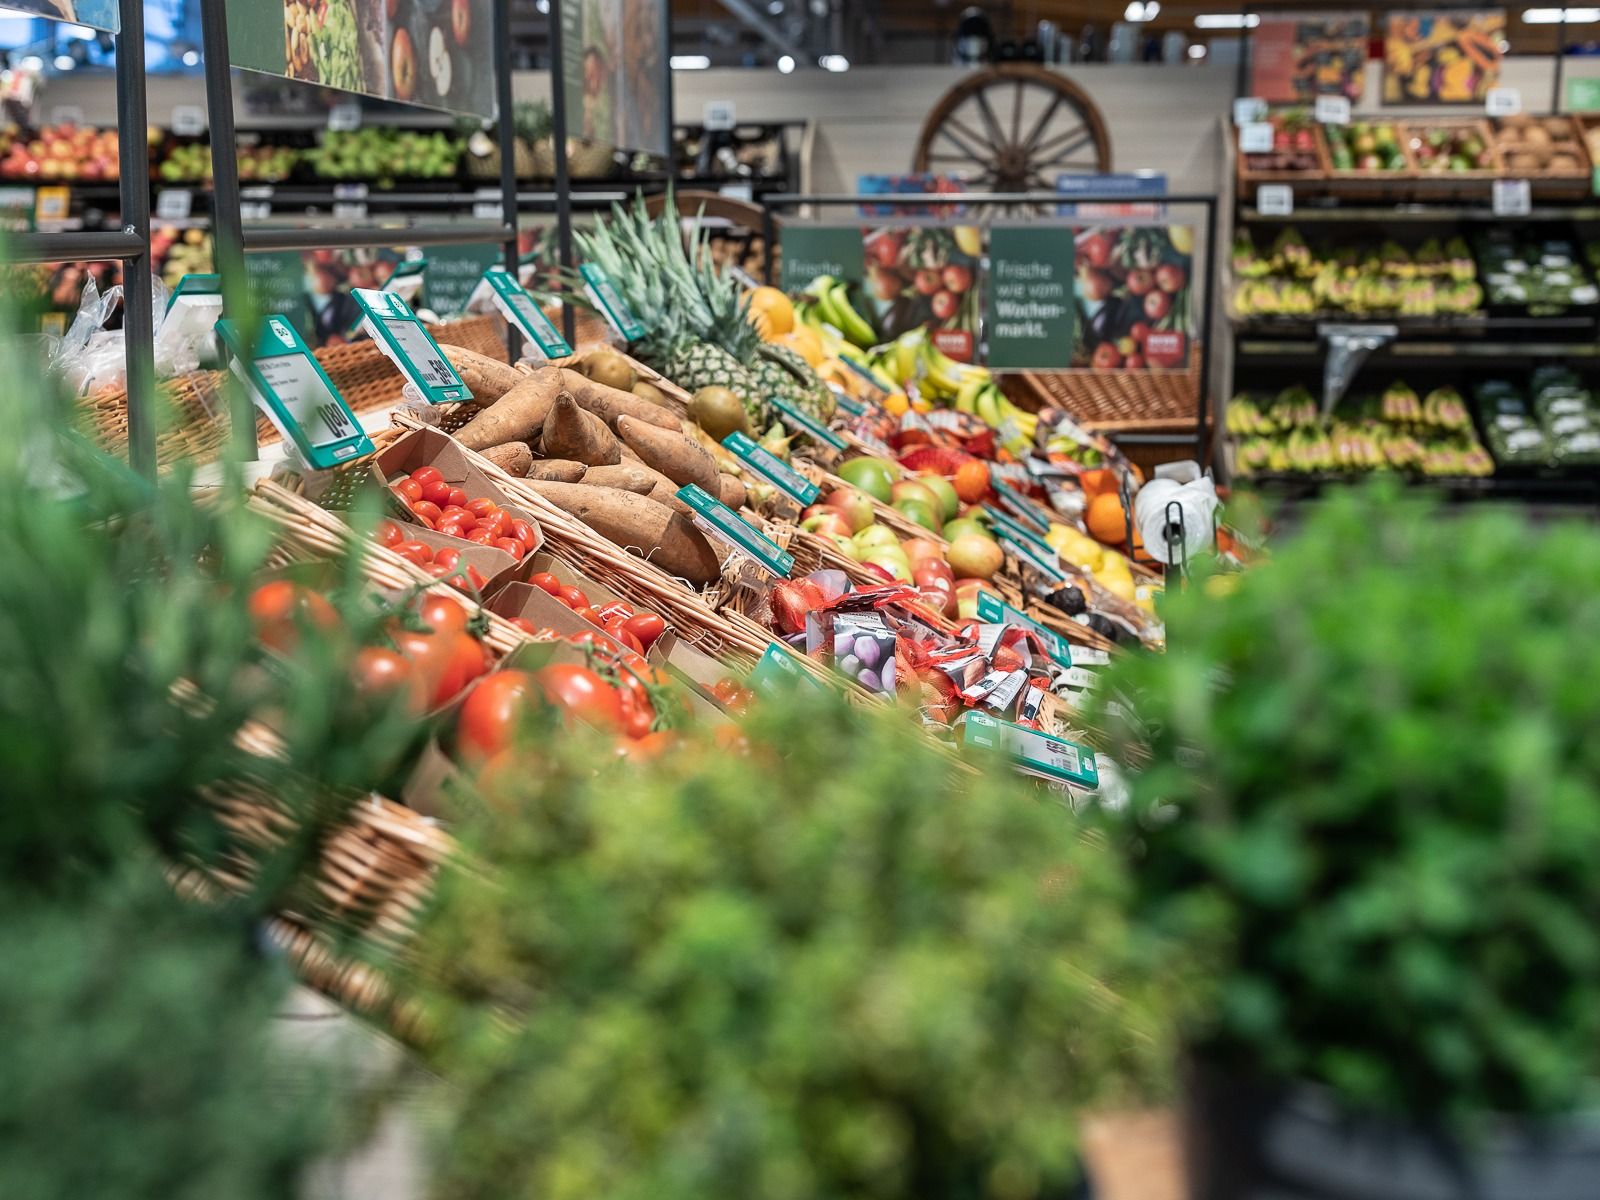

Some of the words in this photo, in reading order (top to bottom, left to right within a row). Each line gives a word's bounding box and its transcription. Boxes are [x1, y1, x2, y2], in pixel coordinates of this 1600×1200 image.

[996, 260, 1052, 278] Frische
[996, 282, 1026, 297] wie
[1028, 284, 1063, 297] vom
[995, 301, 1066, 318] Wochen-
[995, 320, 1047, 338] markt.
